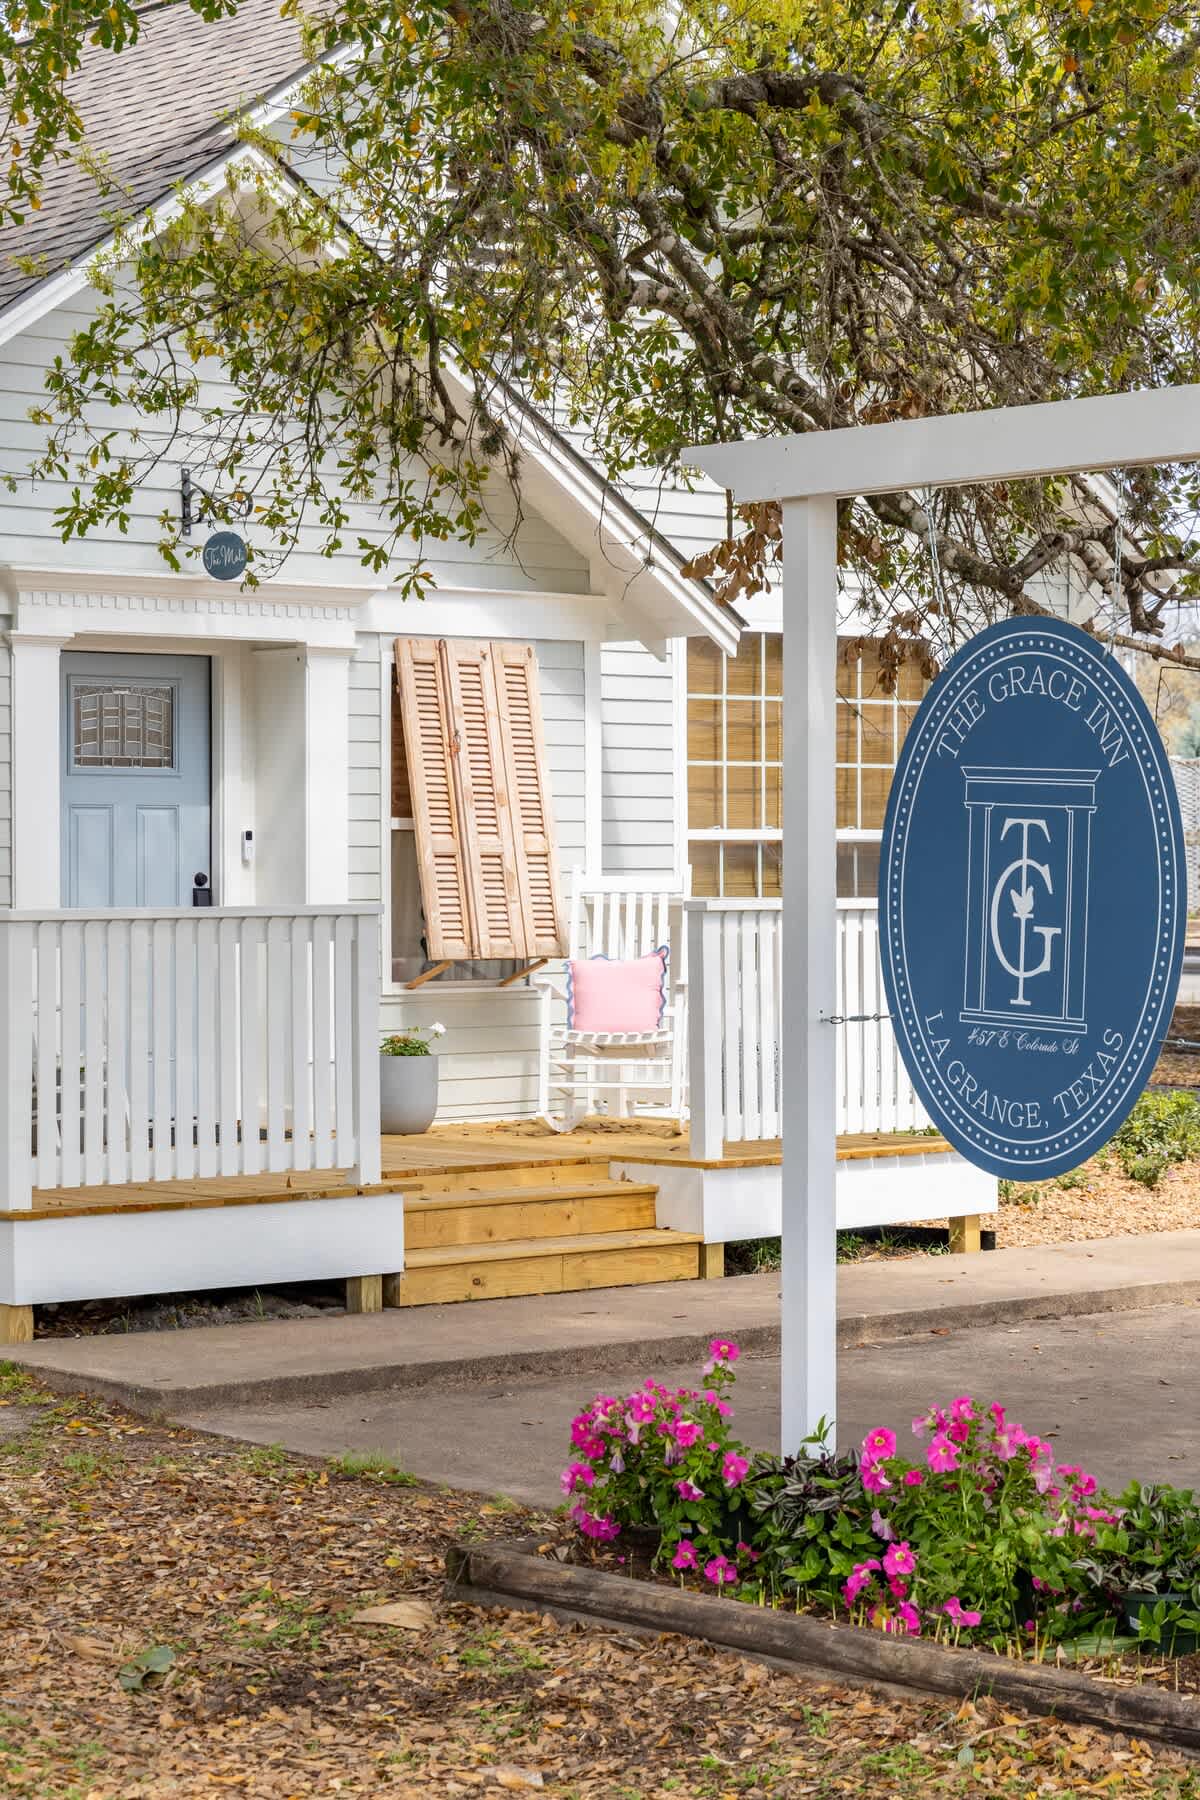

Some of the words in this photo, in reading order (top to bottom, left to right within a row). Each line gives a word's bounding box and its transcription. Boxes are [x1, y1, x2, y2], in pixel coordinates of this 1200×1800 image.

[936, 689, 986, 759] THE
[988, 664, 1087, 712] GRACE
[1083, 698, 1130, 768] INN
[924, 1009, 951, 1060] LA
[946, 1060, 1049, 1129] GRANGE,
[1052, 1028, 1124, 1119] TEXAS
[996, 1029, 1011, 1048] E
[1012, 1030, 1058, 1054] Colorado
[1062, 1037, 1080, 1056] St
